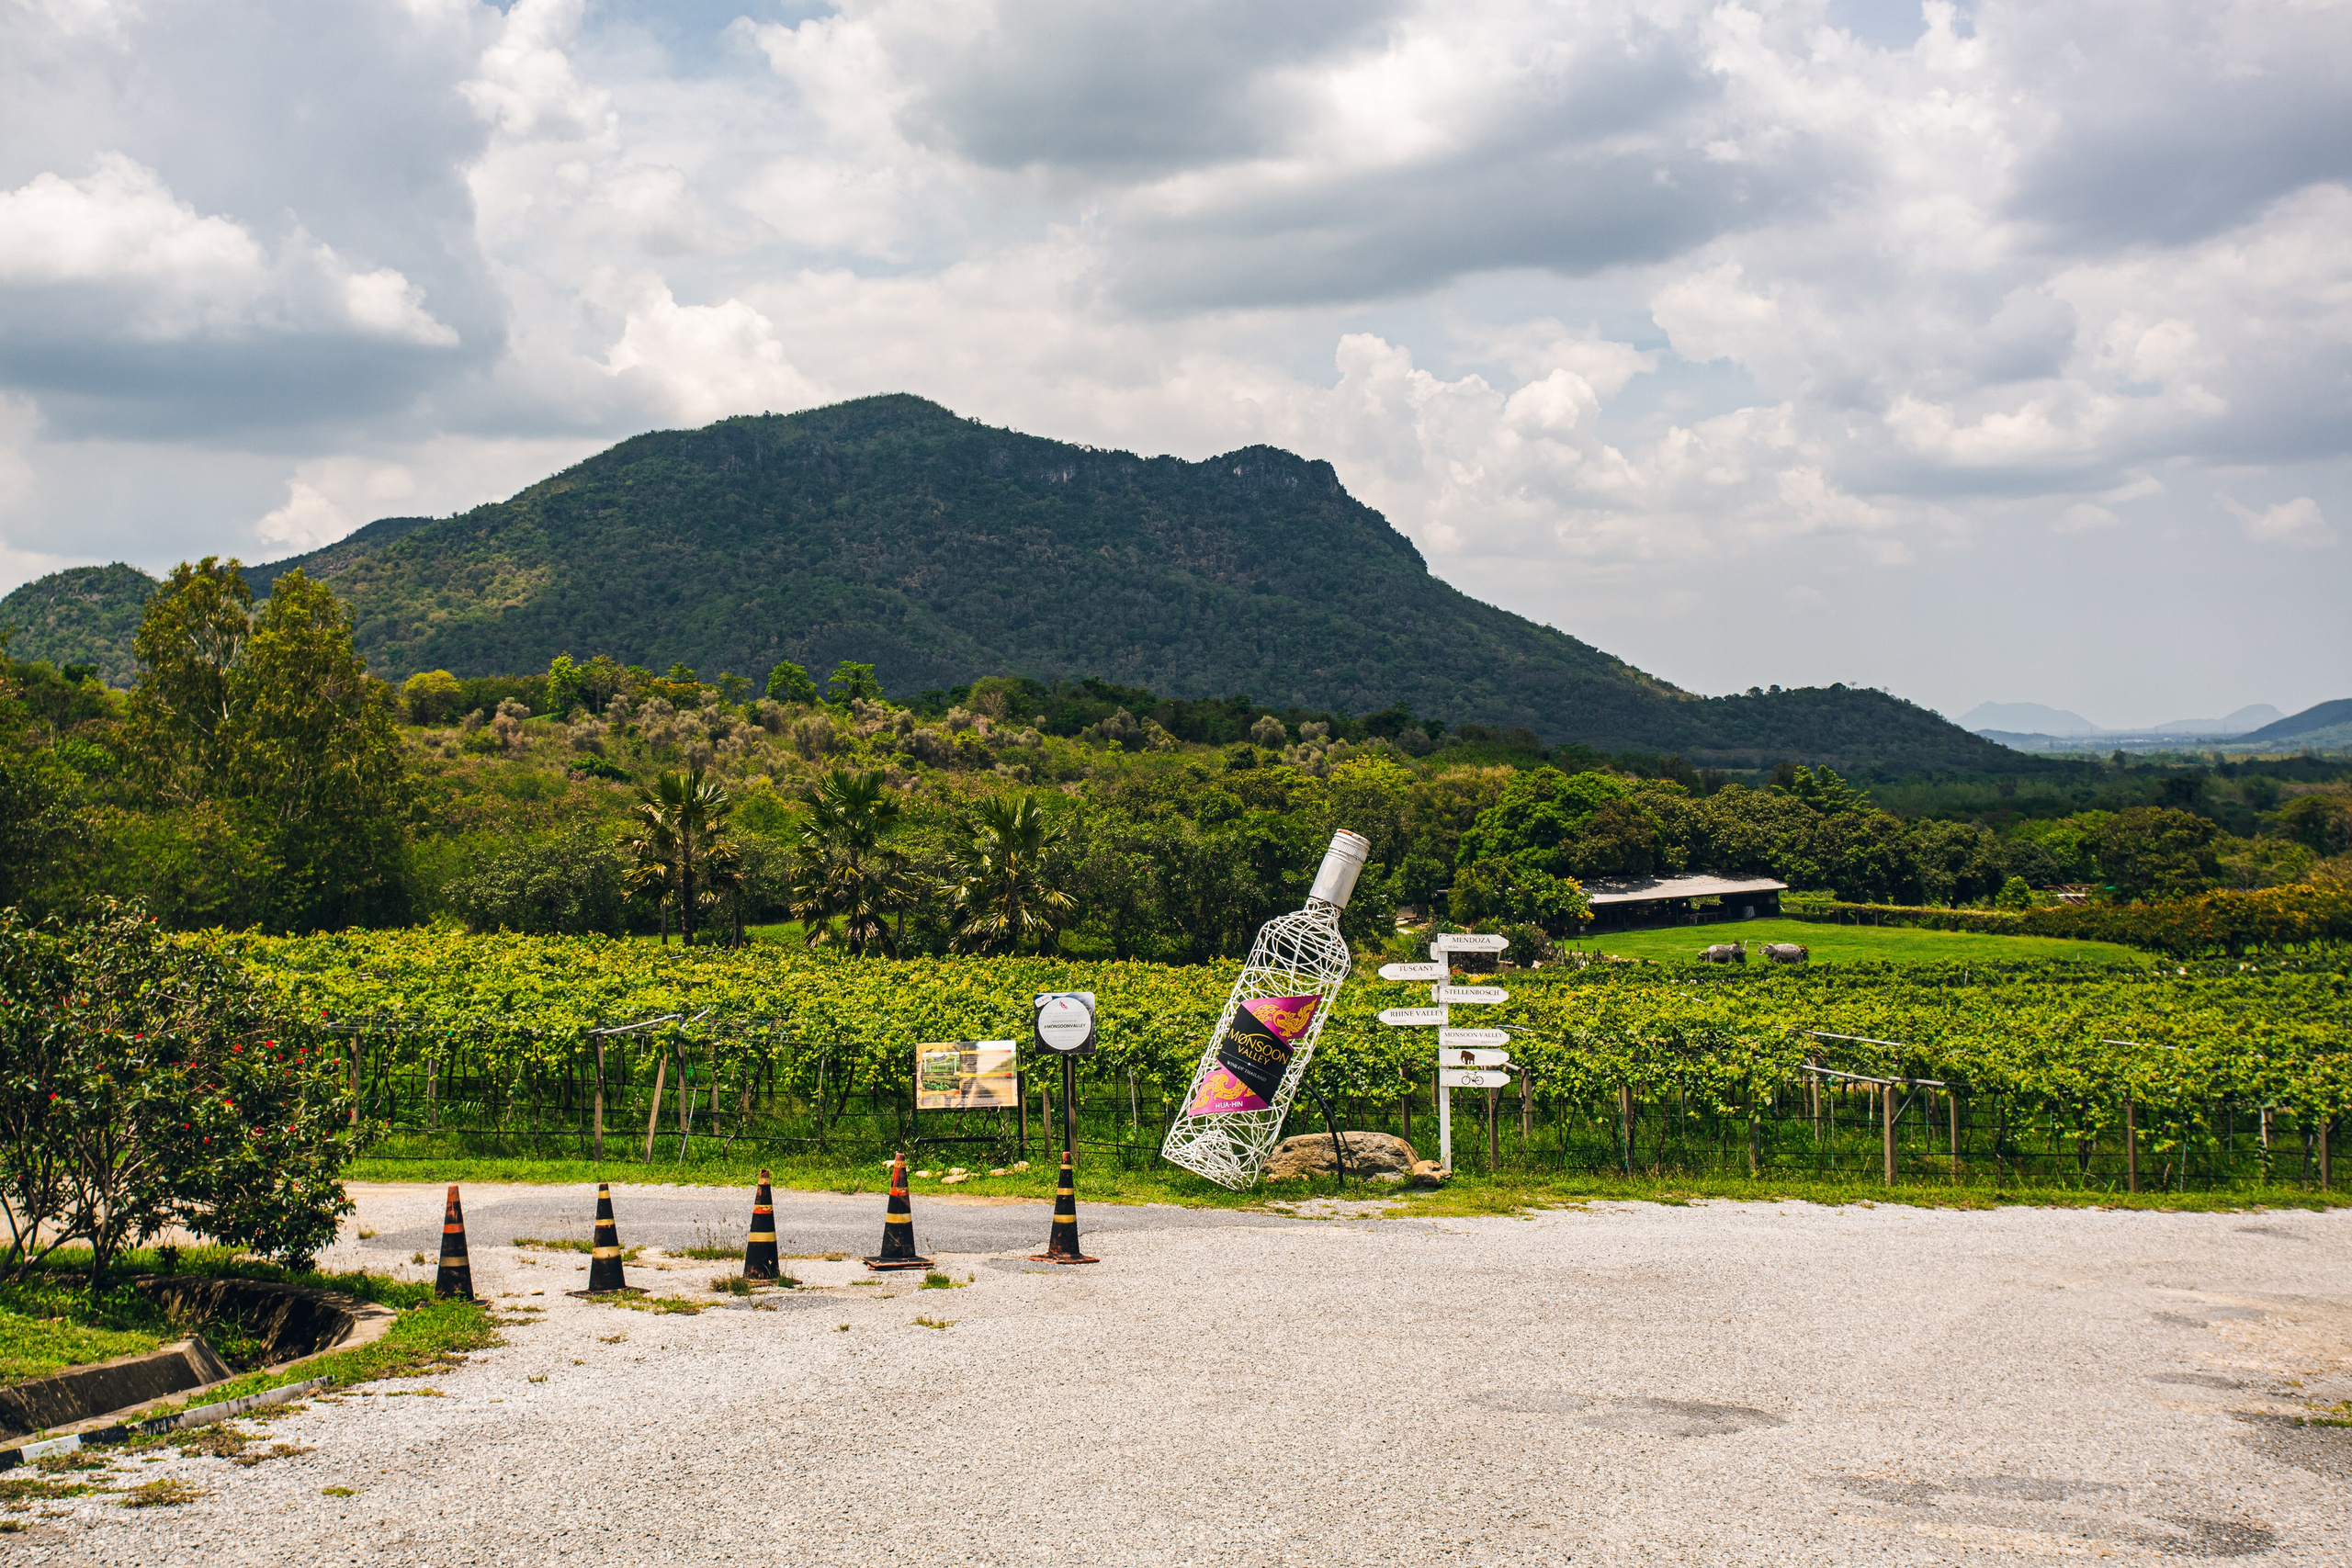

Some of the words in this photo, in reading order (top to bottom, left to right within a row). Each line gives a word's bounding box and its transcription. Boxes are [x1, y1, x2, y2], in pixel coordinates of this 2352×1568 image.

[1238, 1044, 1271, 1066] VALLEY
[1227, 1060, 1238, 1069] WINE
[1244, 1068, 1267, 1082] THAILAND
[1215, 1100, 1243, 1109] HUA-HIN
